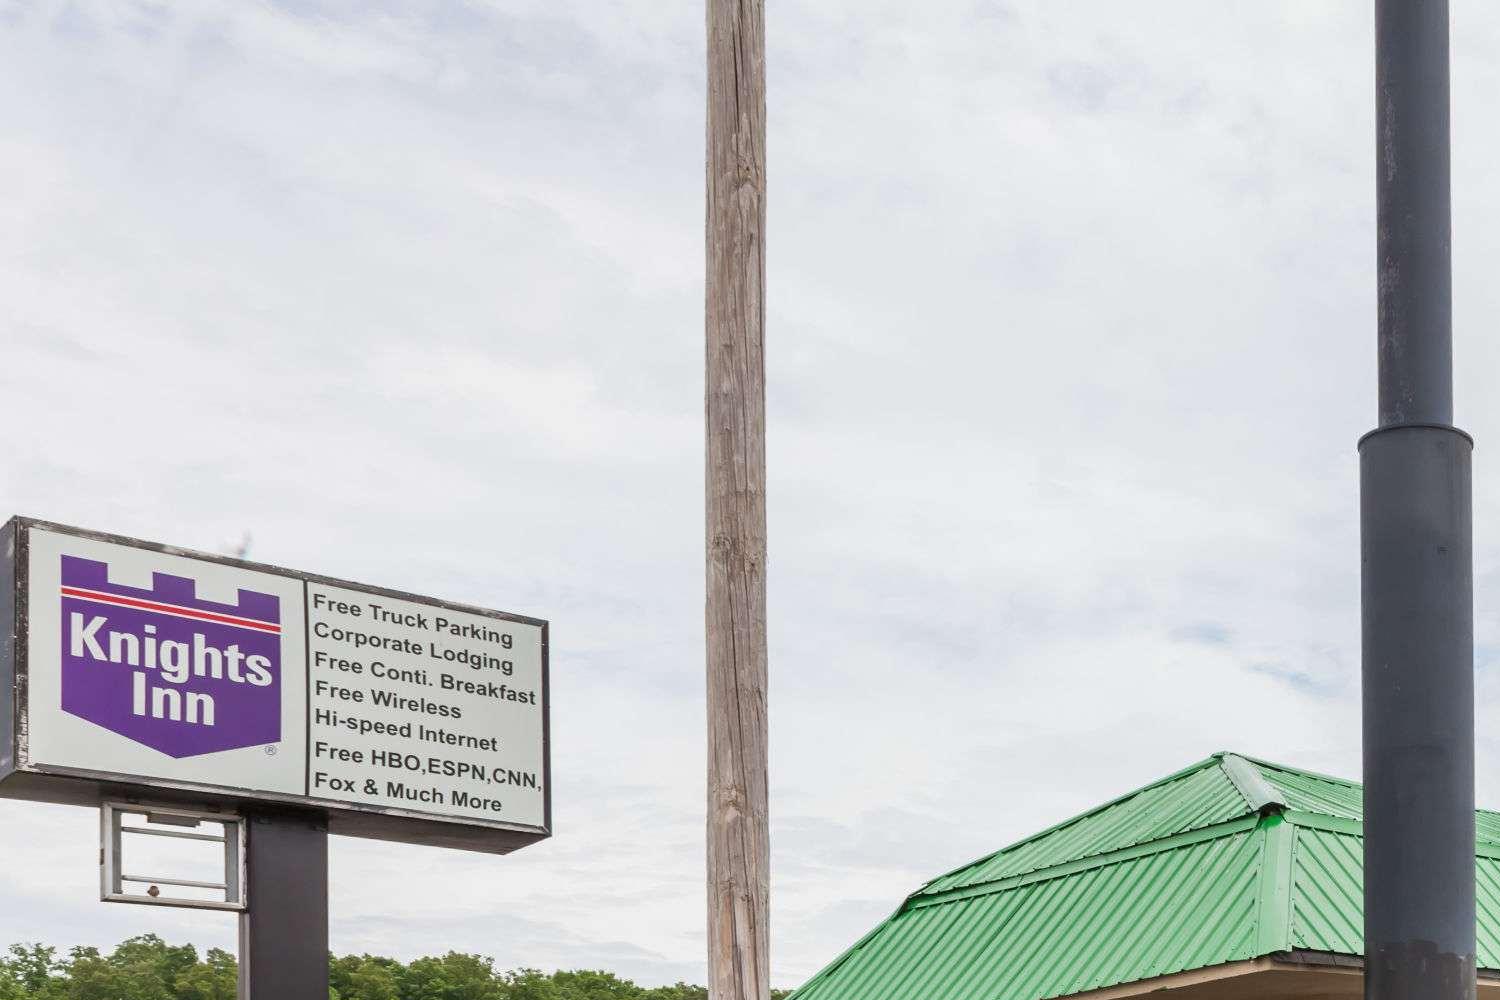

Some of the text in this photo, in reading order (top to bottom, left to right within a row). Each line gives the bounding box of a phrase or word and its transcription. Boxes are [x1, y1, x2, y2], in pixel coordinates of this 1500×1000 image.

[313, 593, 513, 649] Free Truck Parking
[71, 612, 273, 686] Knights
[314, 622, 513, 675] Corporate Lodging
[133, 671, 215, 726] Inn
[315, 651, 536, 705] Free Conti. Breakfast
[315, 680, 461, 719] Free Wireless
[315, 708, 498, 752] Hi-speed Internet
[315, 741, 363, 763] Free
[315, 772, 502, 812] Fox & Much More
